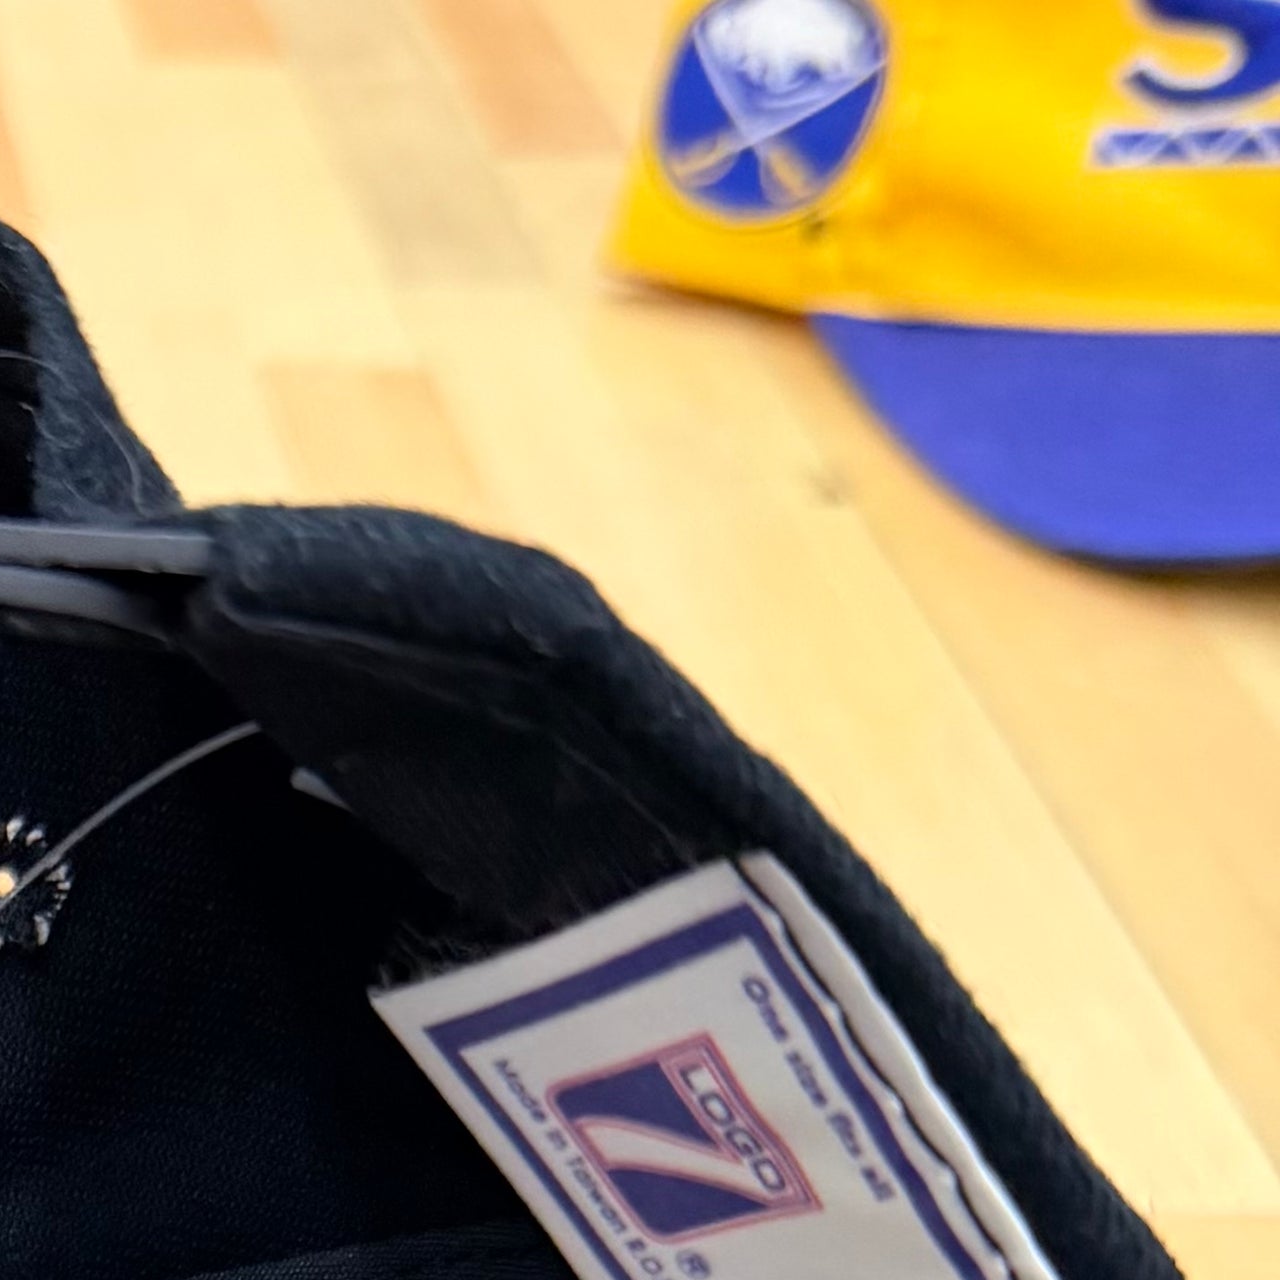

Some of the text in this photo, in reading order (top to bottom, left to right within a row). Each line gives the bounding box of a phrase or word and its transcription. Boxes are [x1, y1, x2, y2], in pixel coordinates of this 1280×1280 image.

[742, 976, 788, 1042] One
[785, 1050, 828, 1107] size
[494, 1059, 546, 1124] Made
[566, 1156, 627, 1235] Taiwan
[679, 1062, 787, 1192] LOGO
